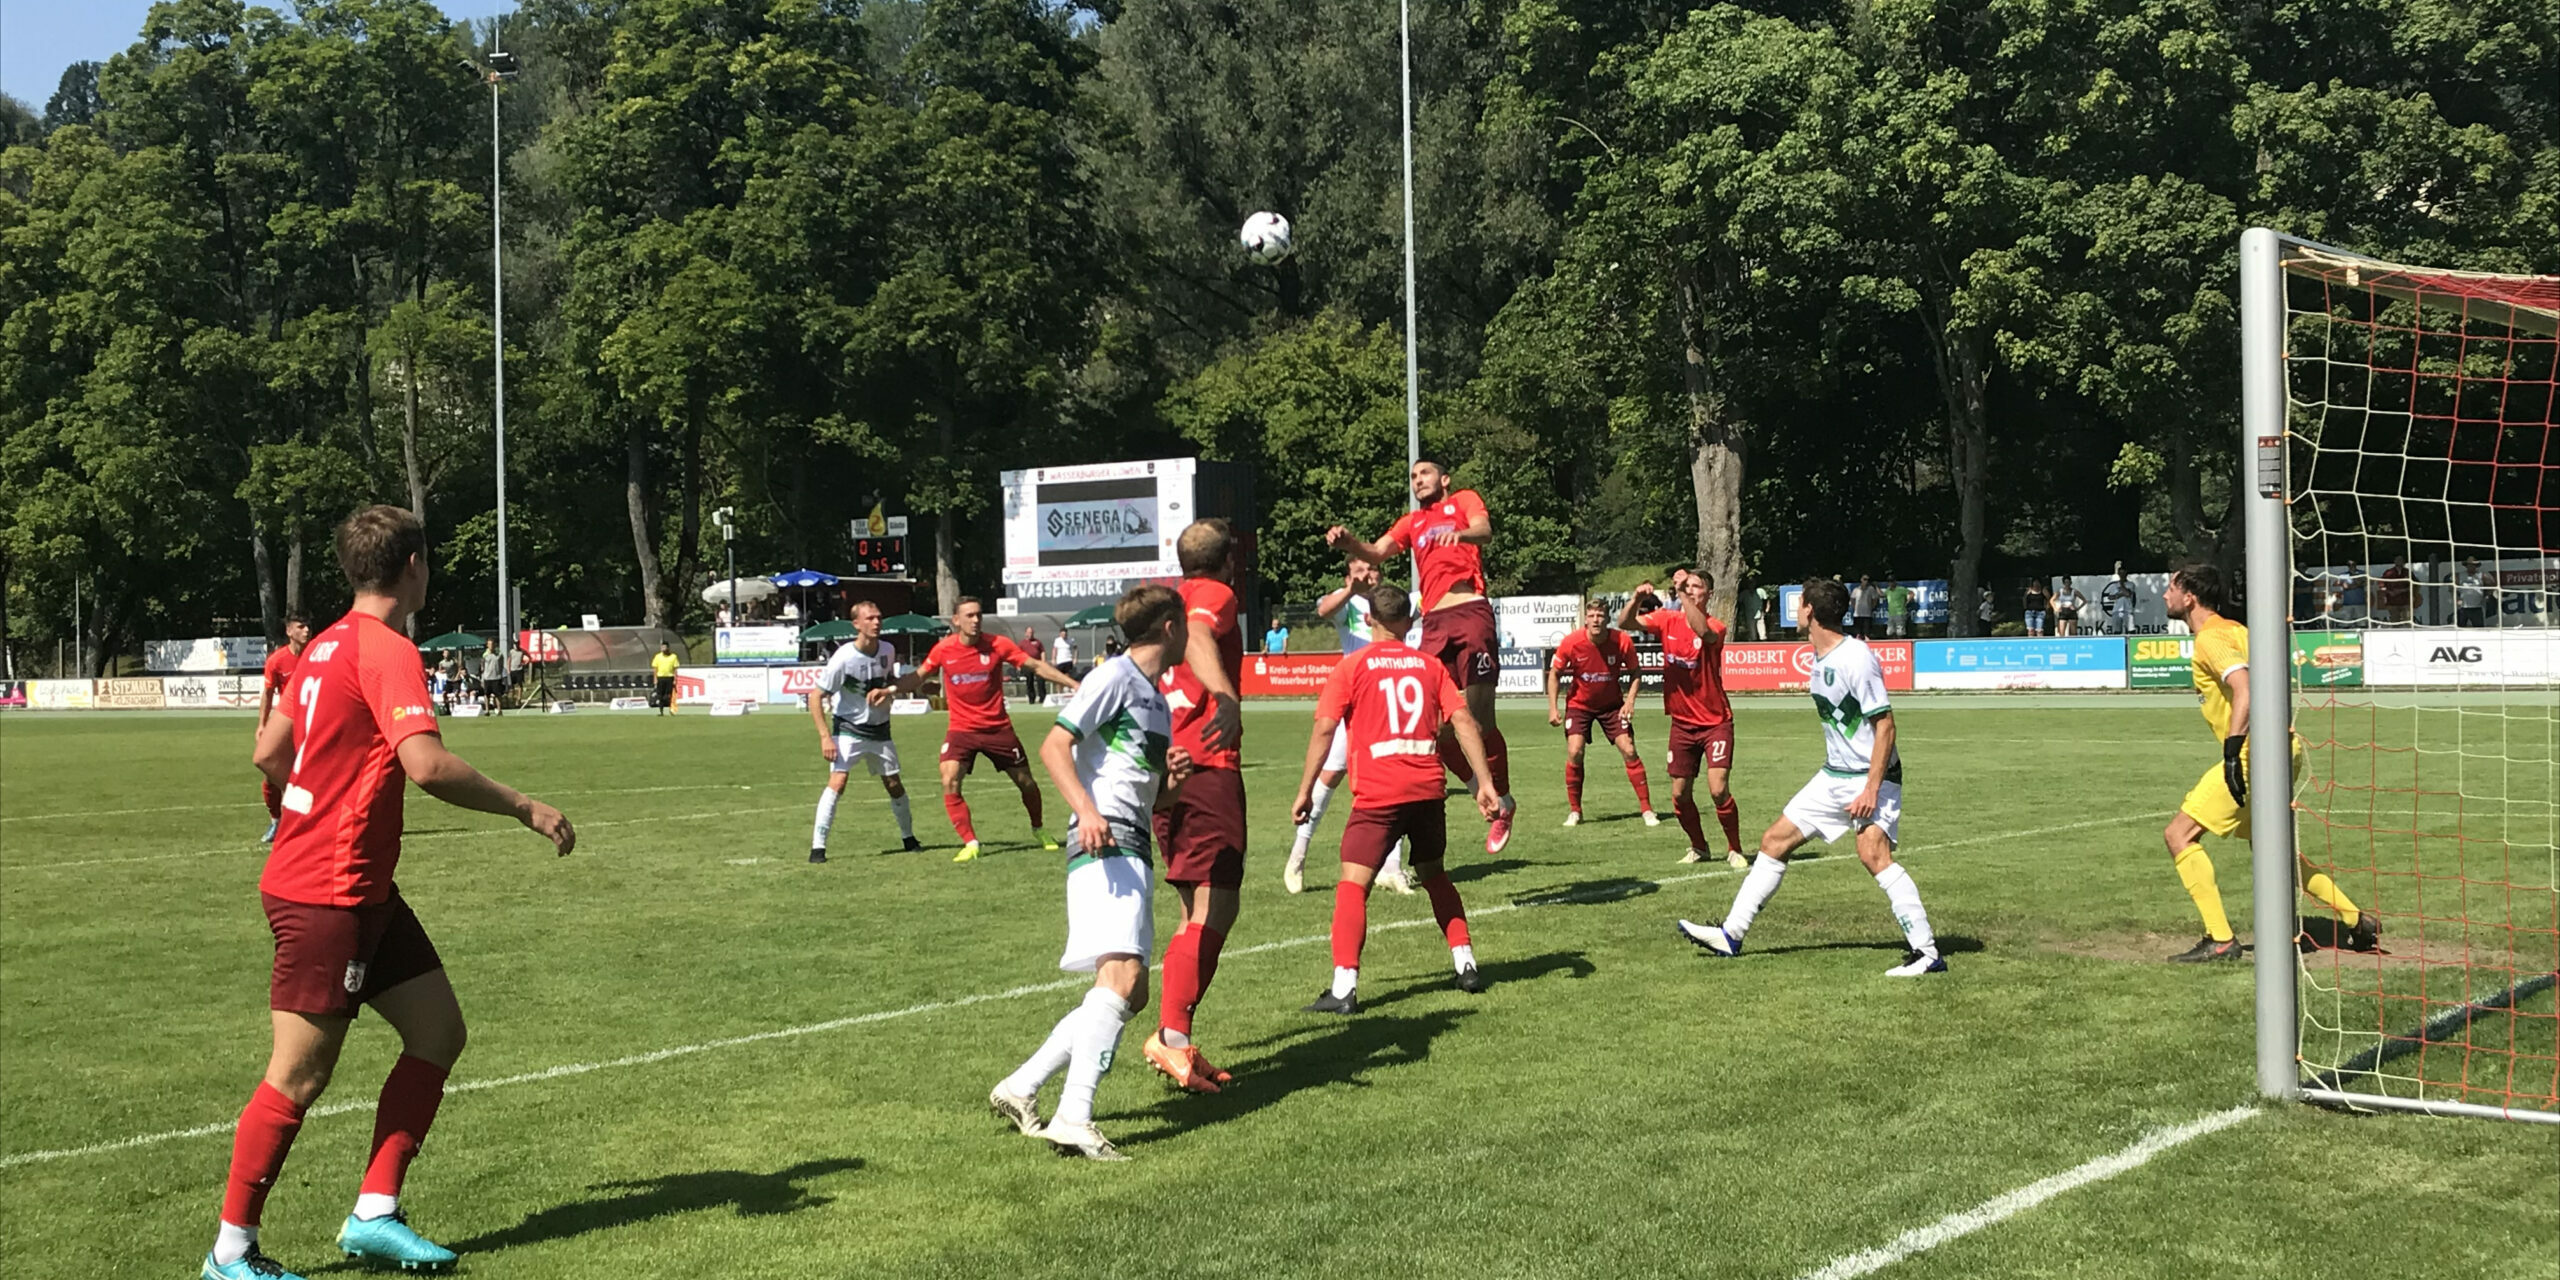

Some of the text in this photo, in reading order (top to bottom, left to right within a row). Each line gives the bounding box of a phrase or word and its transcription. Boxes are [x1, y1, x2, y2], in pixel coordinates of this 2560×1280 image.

[1065, 509, 1120, 526] SENEGA
[871, 557, 889, 573] 45
[1476, 652, 1491, 669] 20
[1725, 650, 1787, 664] ROBERT
[1874, 647, 1907, 662] KER
[2429, 646, 2483, 662] AVG
[1269, 665, 1291, 675] Kreis-
[1292, 665, 1306, 674] und
[1366, 655, 1426, 671] BARTHUBER
[1725, 666, 1787, 676] Immobilien
[113, 680, 162, 694] STEMMER
[1270, 676, 1327, 686] Wasserburg am
[1379, 675, 1424, 734] 19
[1712, 741, 1726, 756] 27
